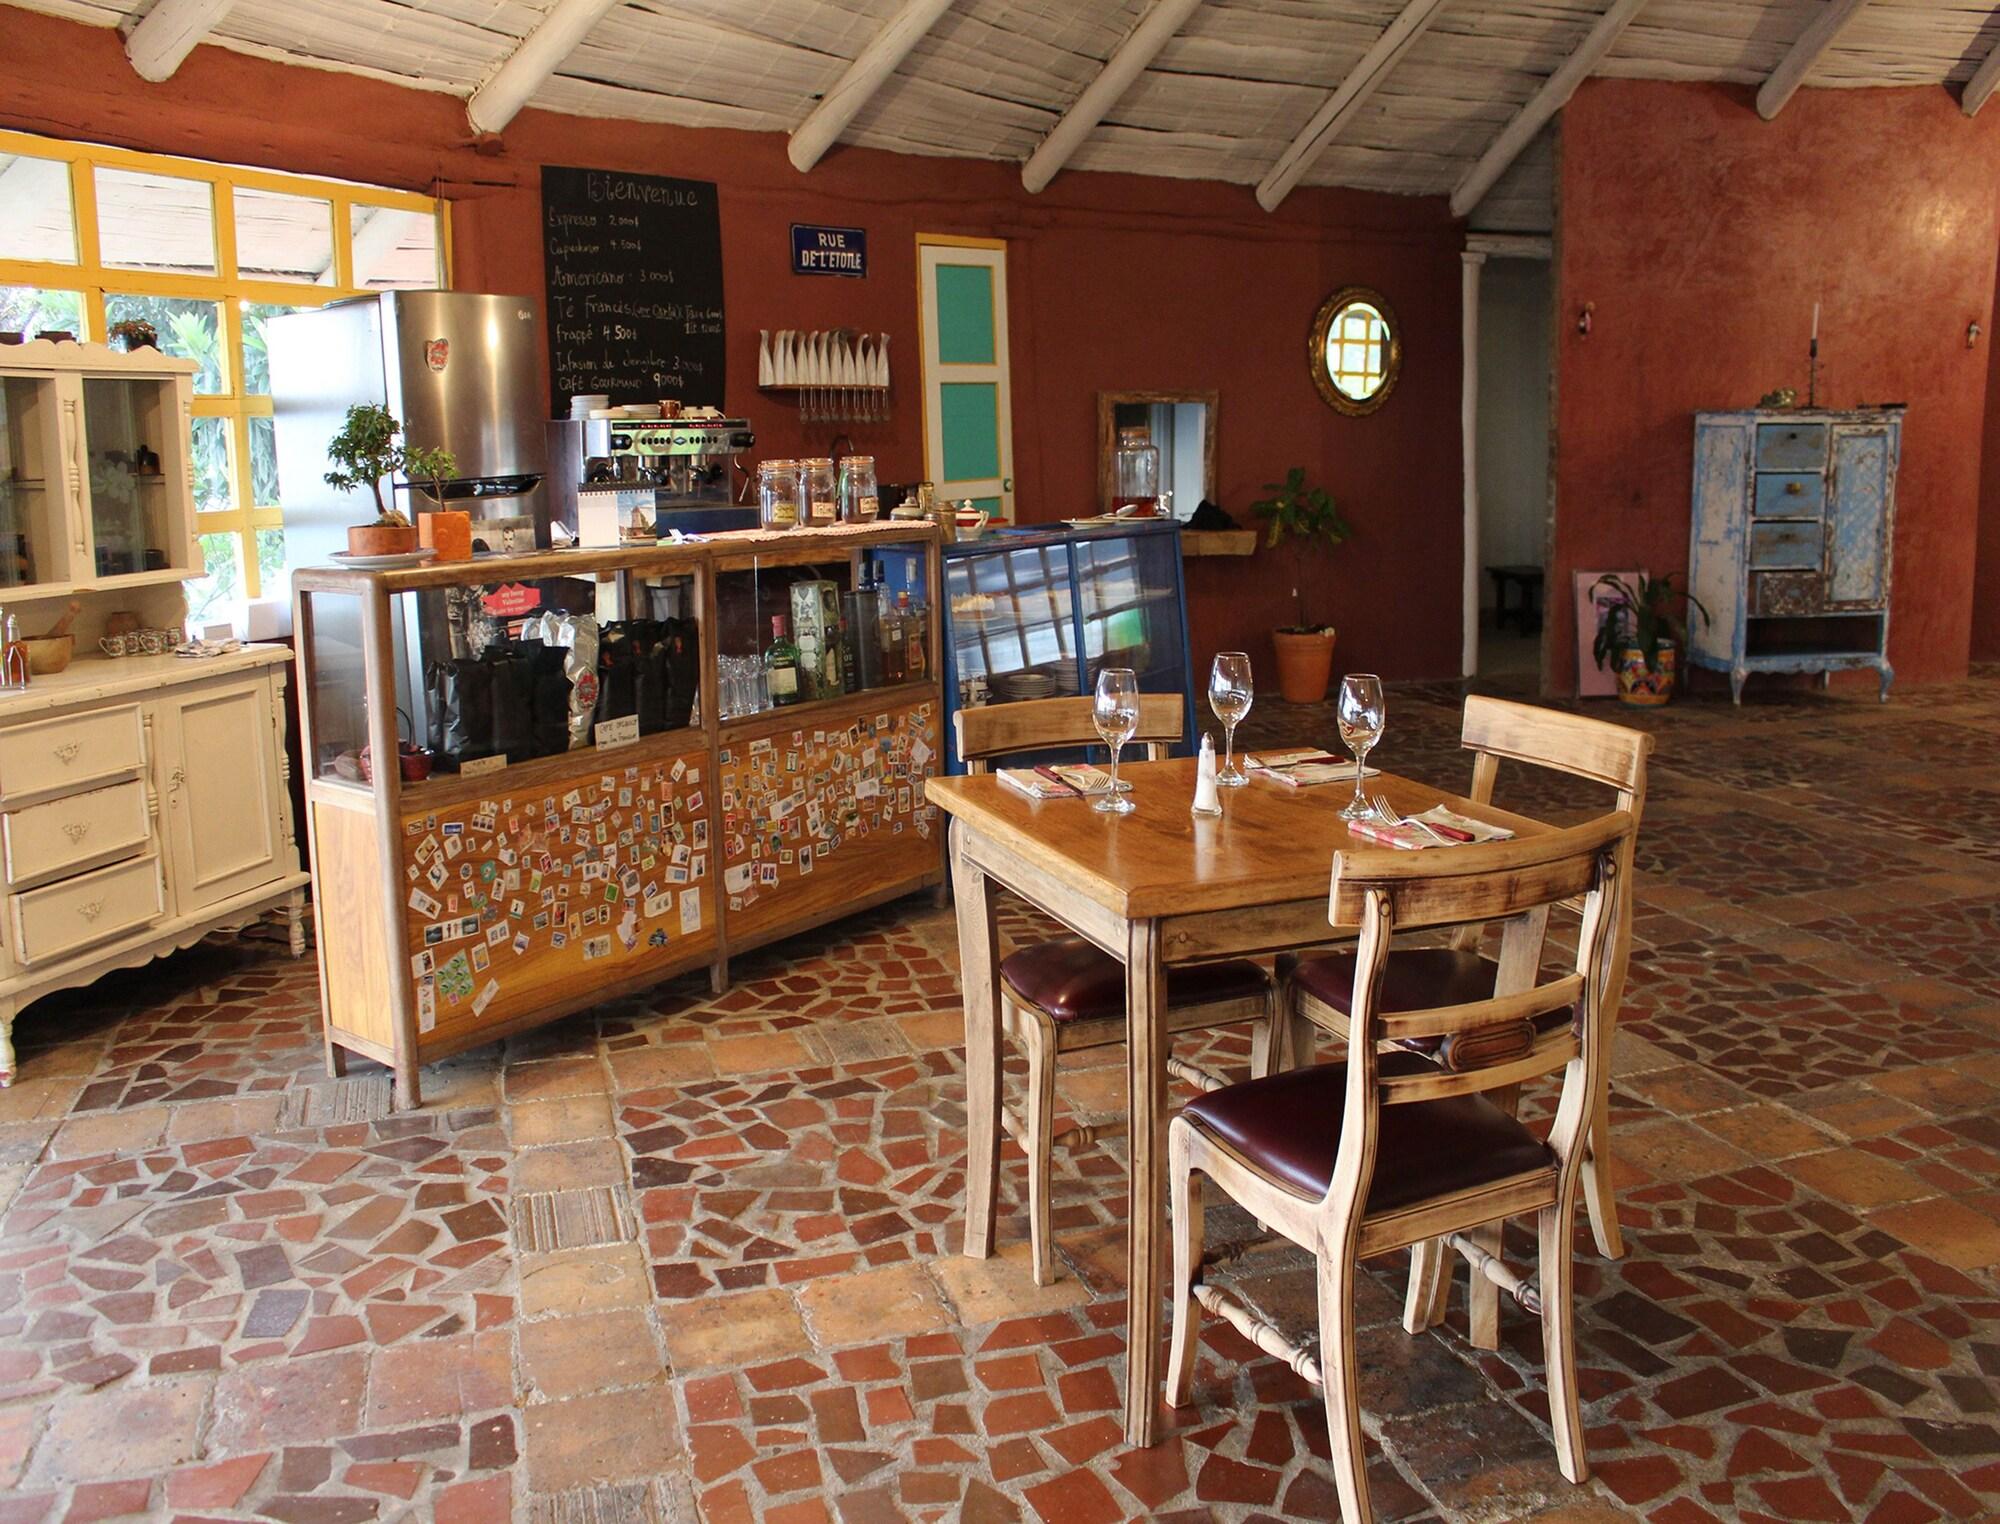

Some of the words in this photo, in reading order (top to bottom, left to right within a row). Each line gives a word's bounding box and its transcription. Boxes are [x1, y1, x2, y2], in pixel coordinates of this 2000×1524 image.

[586, 172, 699, 207] Bienvenue
[817, 232, 846, 248] RUE
[801, 249, 817, 267] DE
[553, 295, 575, 320] Té
